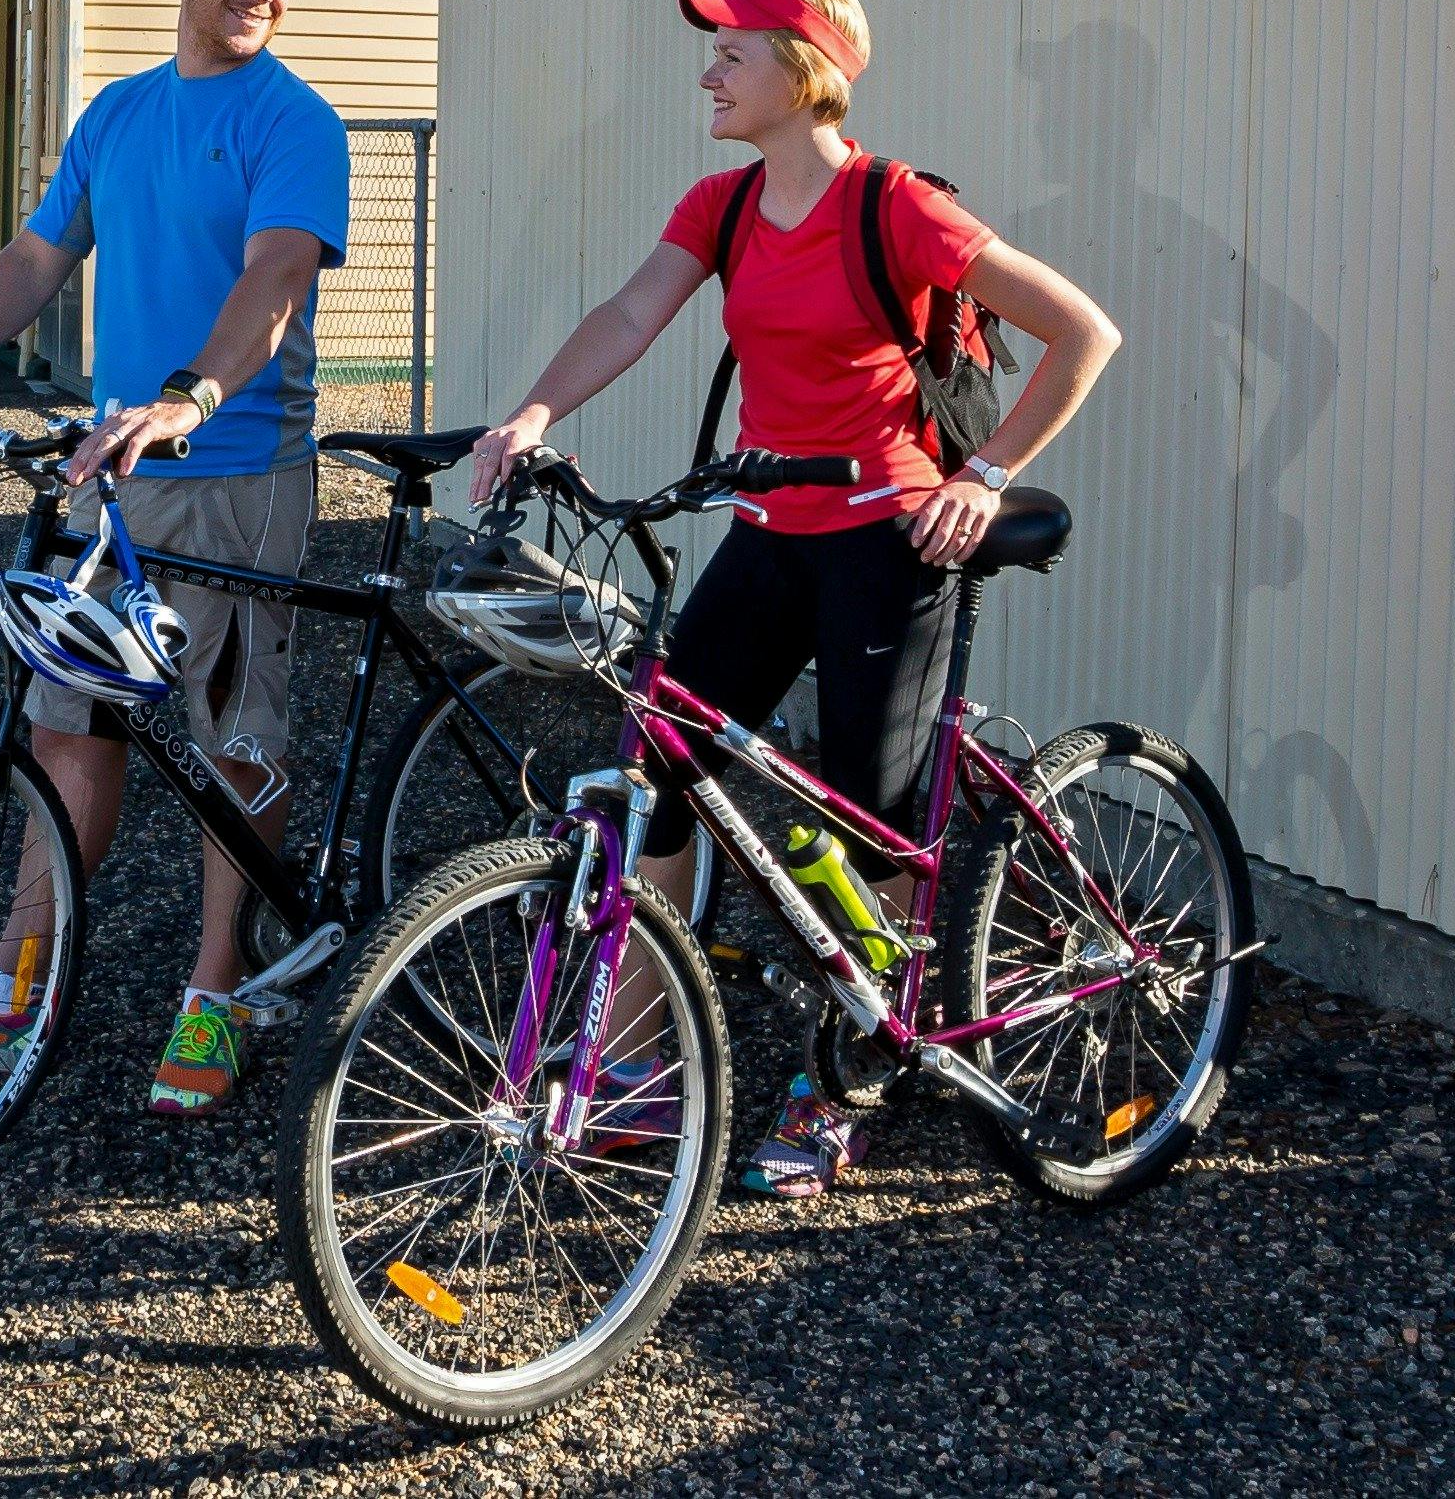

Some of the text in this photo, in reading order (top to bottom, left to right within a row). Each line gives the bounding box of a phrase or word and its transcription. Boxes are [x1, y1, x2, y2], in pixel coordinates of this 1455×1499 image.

[143, 563, 293, 602] ROSSWAY
[127, 703, 210, 791] goose
[584, 960, 611, 1044] ZOOM
